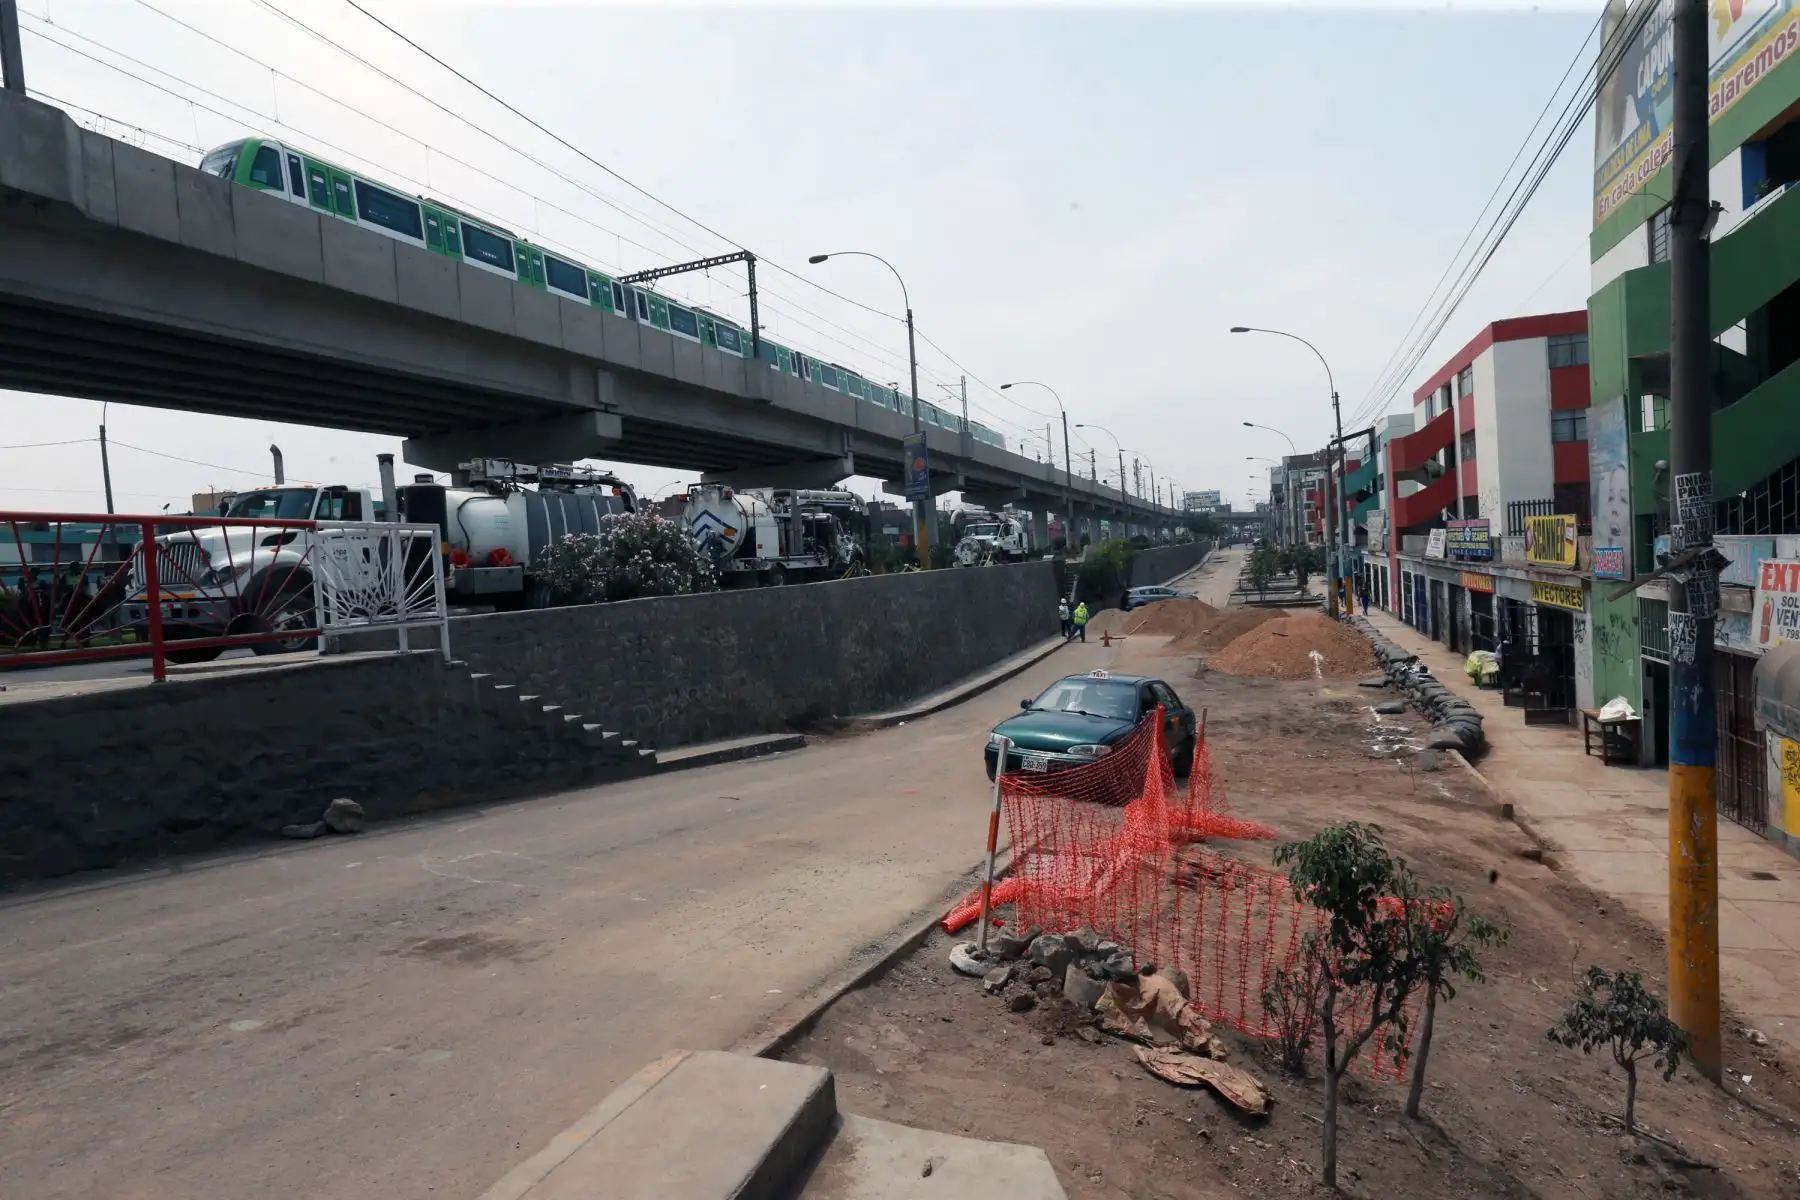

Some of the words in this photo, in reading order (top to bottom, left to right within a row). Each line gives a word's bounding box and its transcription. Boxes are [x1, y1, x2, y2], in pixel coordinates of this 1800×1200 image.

[1613, 174, 1635, 204] cada
[1638, 131, 1674, 183] colegi
[1710, 21, 1798, 117] alaremos
[1761, 563, 1800, 593] EXT
[1532, 583, 1583, 607] INYECTORES
